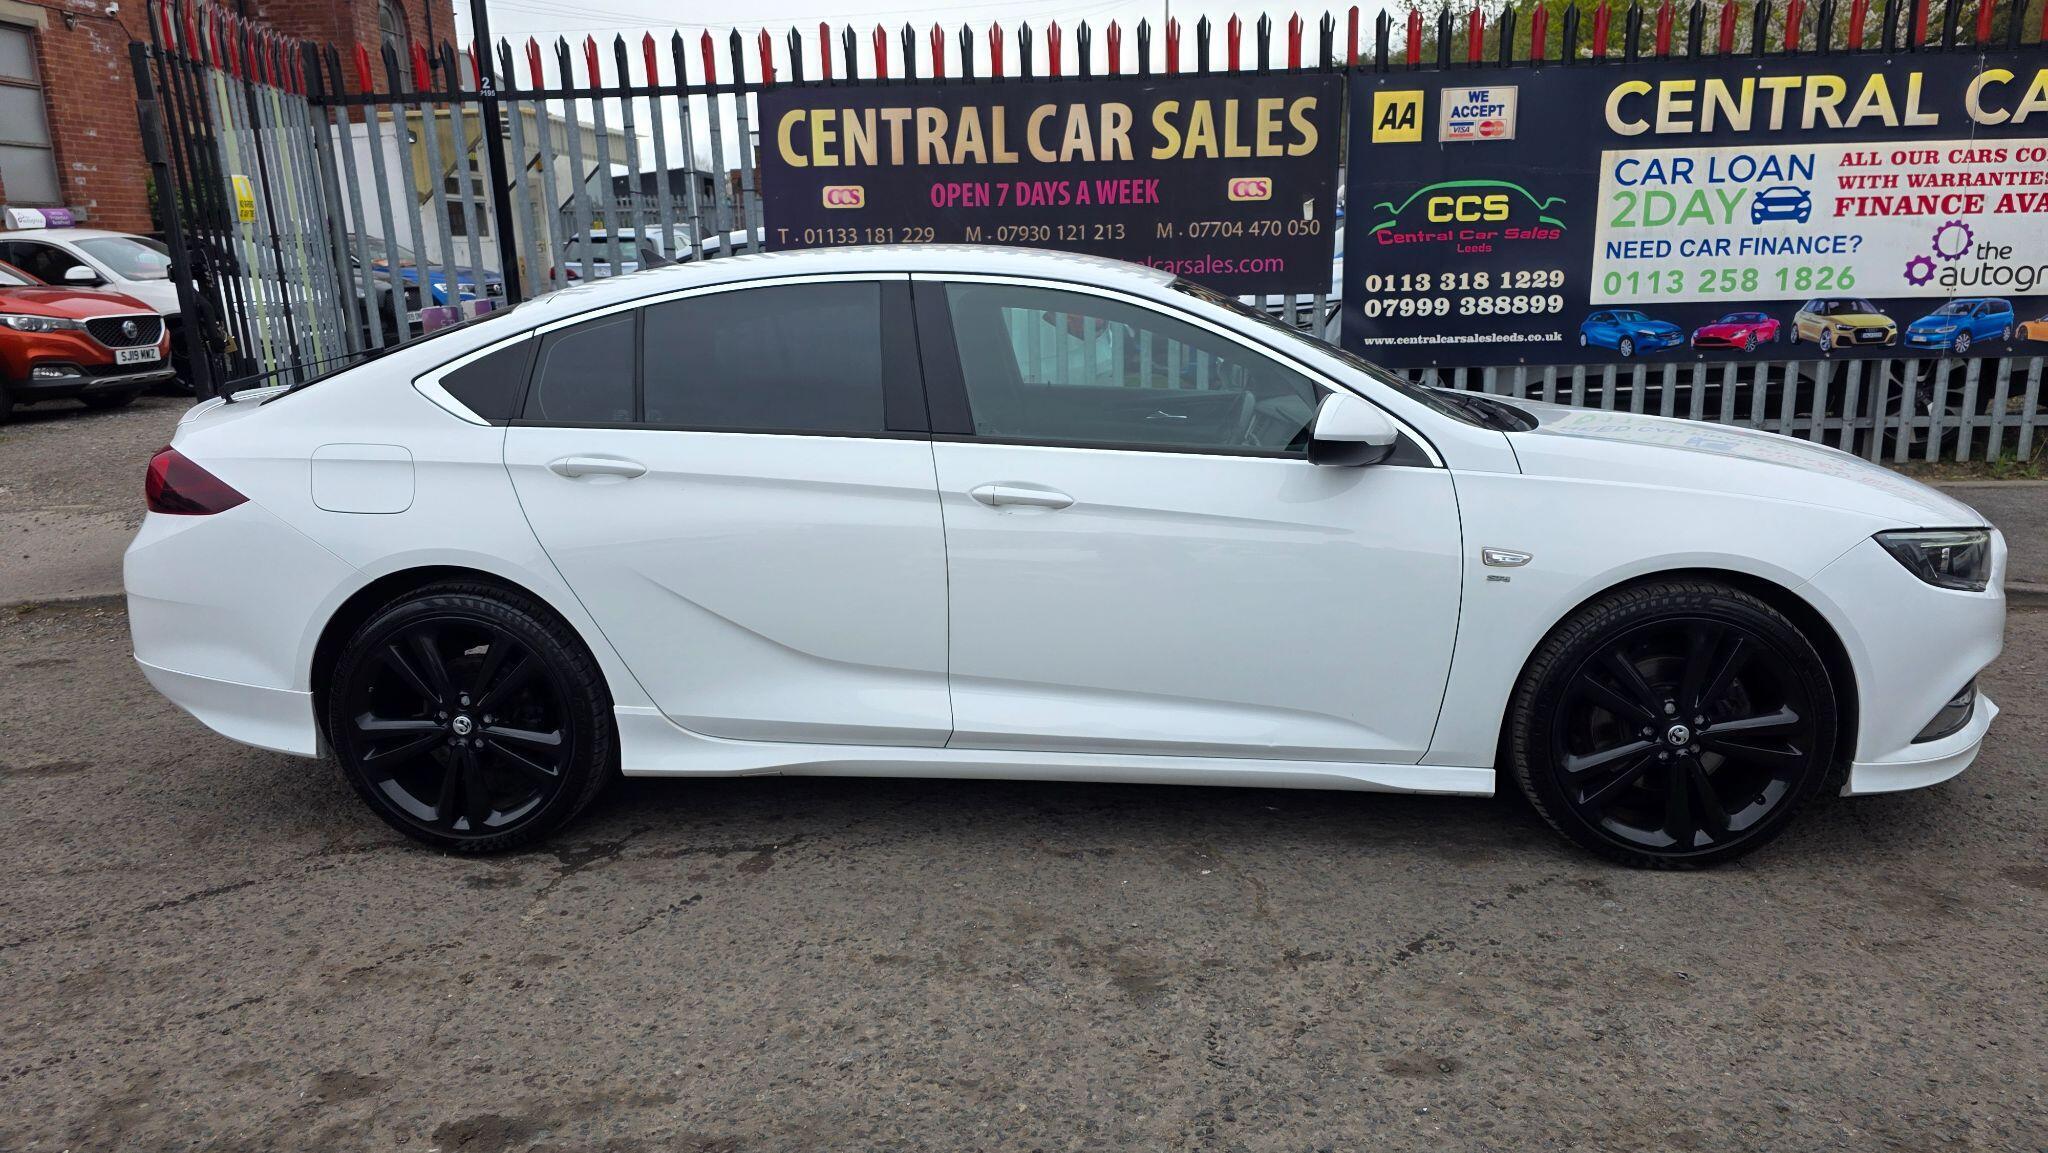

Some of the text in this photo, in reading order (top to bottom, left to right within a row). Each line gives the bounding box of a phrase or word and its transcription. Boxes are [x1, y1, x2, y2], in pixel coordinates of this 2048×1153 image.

[481, 76, 491, 89] 2
[1468, 90, 1489, 103] WE
[1605, 72, 1939, 136] CENTRAL
[1378, 102, 1416, 130] AA
[1451, 104, 1505, 118] ACCEPT
[777, 96, 1319, 167] CENTRAL CAR SALES
[1839, 147, 2048, 167] ALL OUR CARS CO
[1614, 153, 1815, 186] CAR LOAN
[1232, 180, 1268, 198] CCS
[1837, 171, 2048, 190] WITH WARRANTIE
[827, 188, 861, 205] CCS
[930, 179, 1160, 208] OPEN 7 DAYS A WEEK
[1427, 194, 1509, 223] CCS
[1610, 187, 1748, 228] 2DAY
[1833, 193, 1985, 217] FINANCE
[804, 228, 858, 244] 01133
[865, 227, 894, 244] 181
[901, 226, 935, 243] 229
[997, 225, 1050, 242] 07930
[1057, 224, 1085, 241] 121
[1094, 223, 1125, 241] 213
[1189, 221, 1243, 238] 07704
[1249, 219, 1282, 236] 470
[1287, 219, 1321, 236] 050
[1376, 226, 1561, 245] Central Car Sales
[1457, 243, 1493, 253] Leeds
[1606, 234, 1863, 259] NEED CAR FINANCE?
[1976, 241, 2013, 260] the
[1365, 270, 1565, 293] 0113 318 1229
[1603, 265, 1856, 296] 0113 258 1826
[1939, 262, 2048, 292] autogr
[1364, 294, 1564, 318] 07999 388899
[1364, 331, 1563, 346] www.centralcarsalesleeds.co.uk
